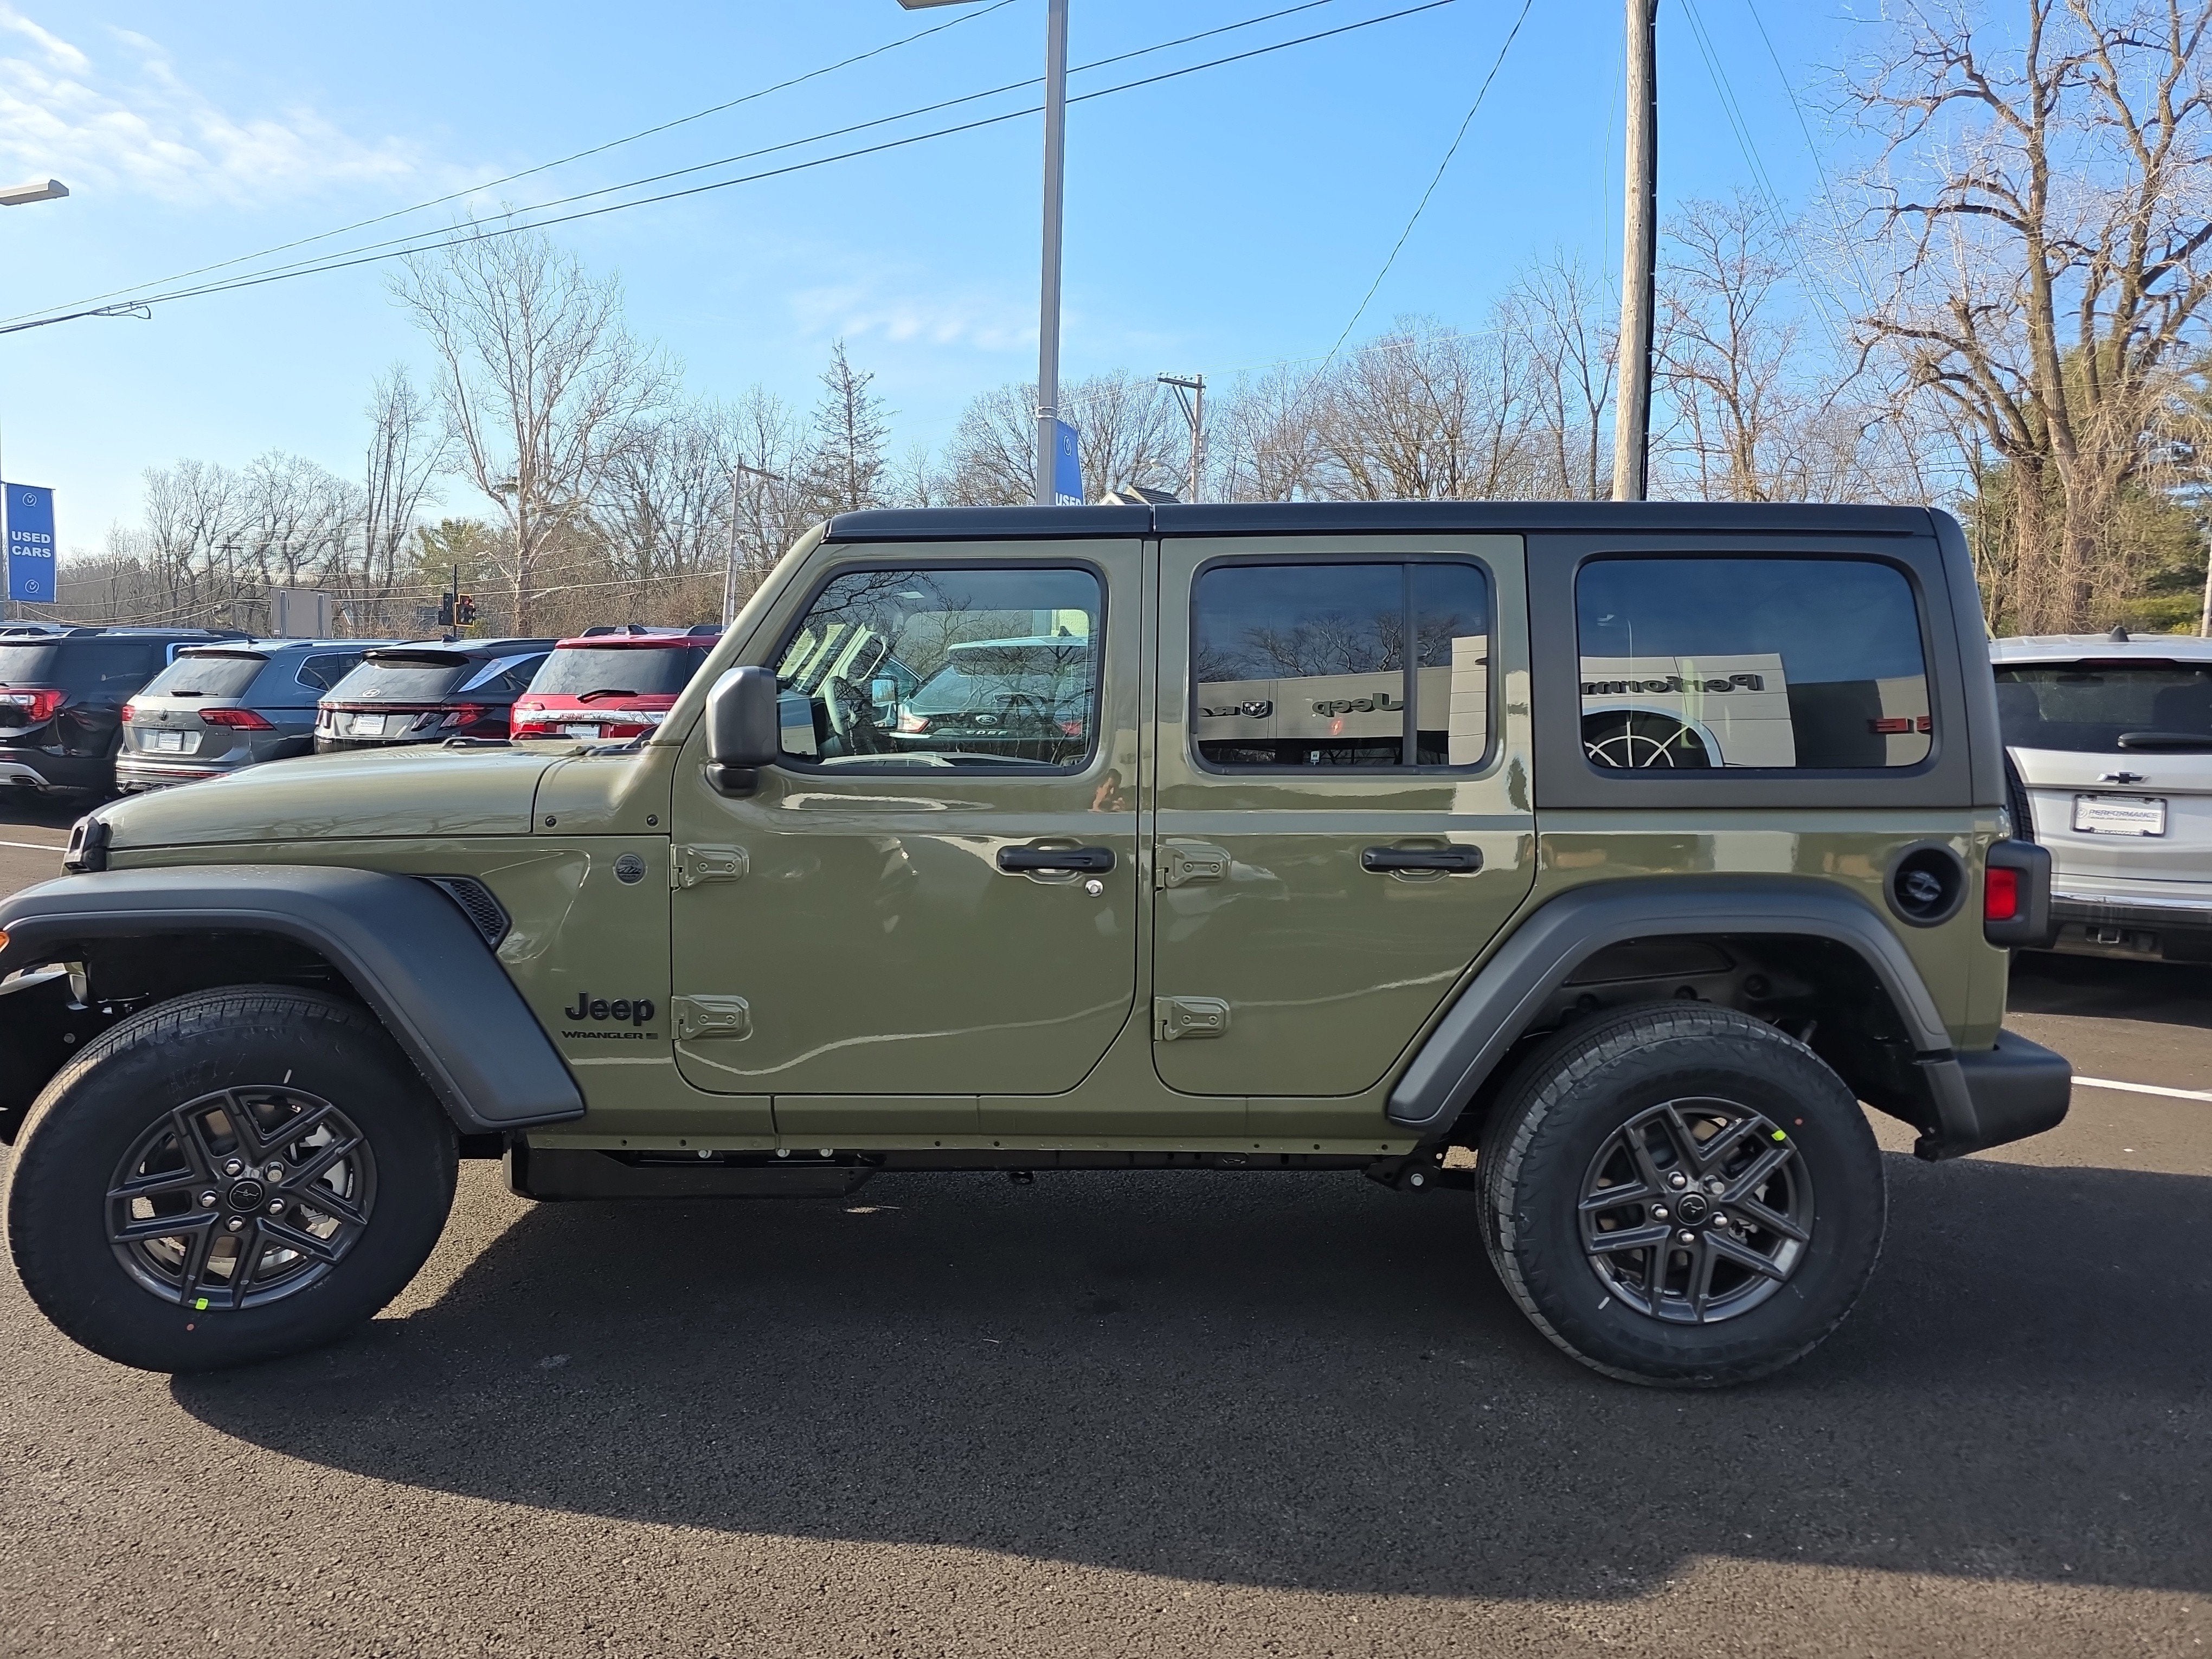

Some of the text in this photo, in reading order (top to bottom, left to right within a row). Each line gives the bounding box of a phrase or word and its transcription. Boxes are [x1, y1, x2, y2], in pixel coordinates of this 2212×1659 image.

[11, 530, 51, 544] USED
[11, 545, 52, 558] CARS
[560, 712, 590, 721] GMC
[2089, 809, 2162, 819] PERFORMANCE
[564, 992, 654, 1026] Jeep
[561, 1031, 644, 1039] WRANGLER
